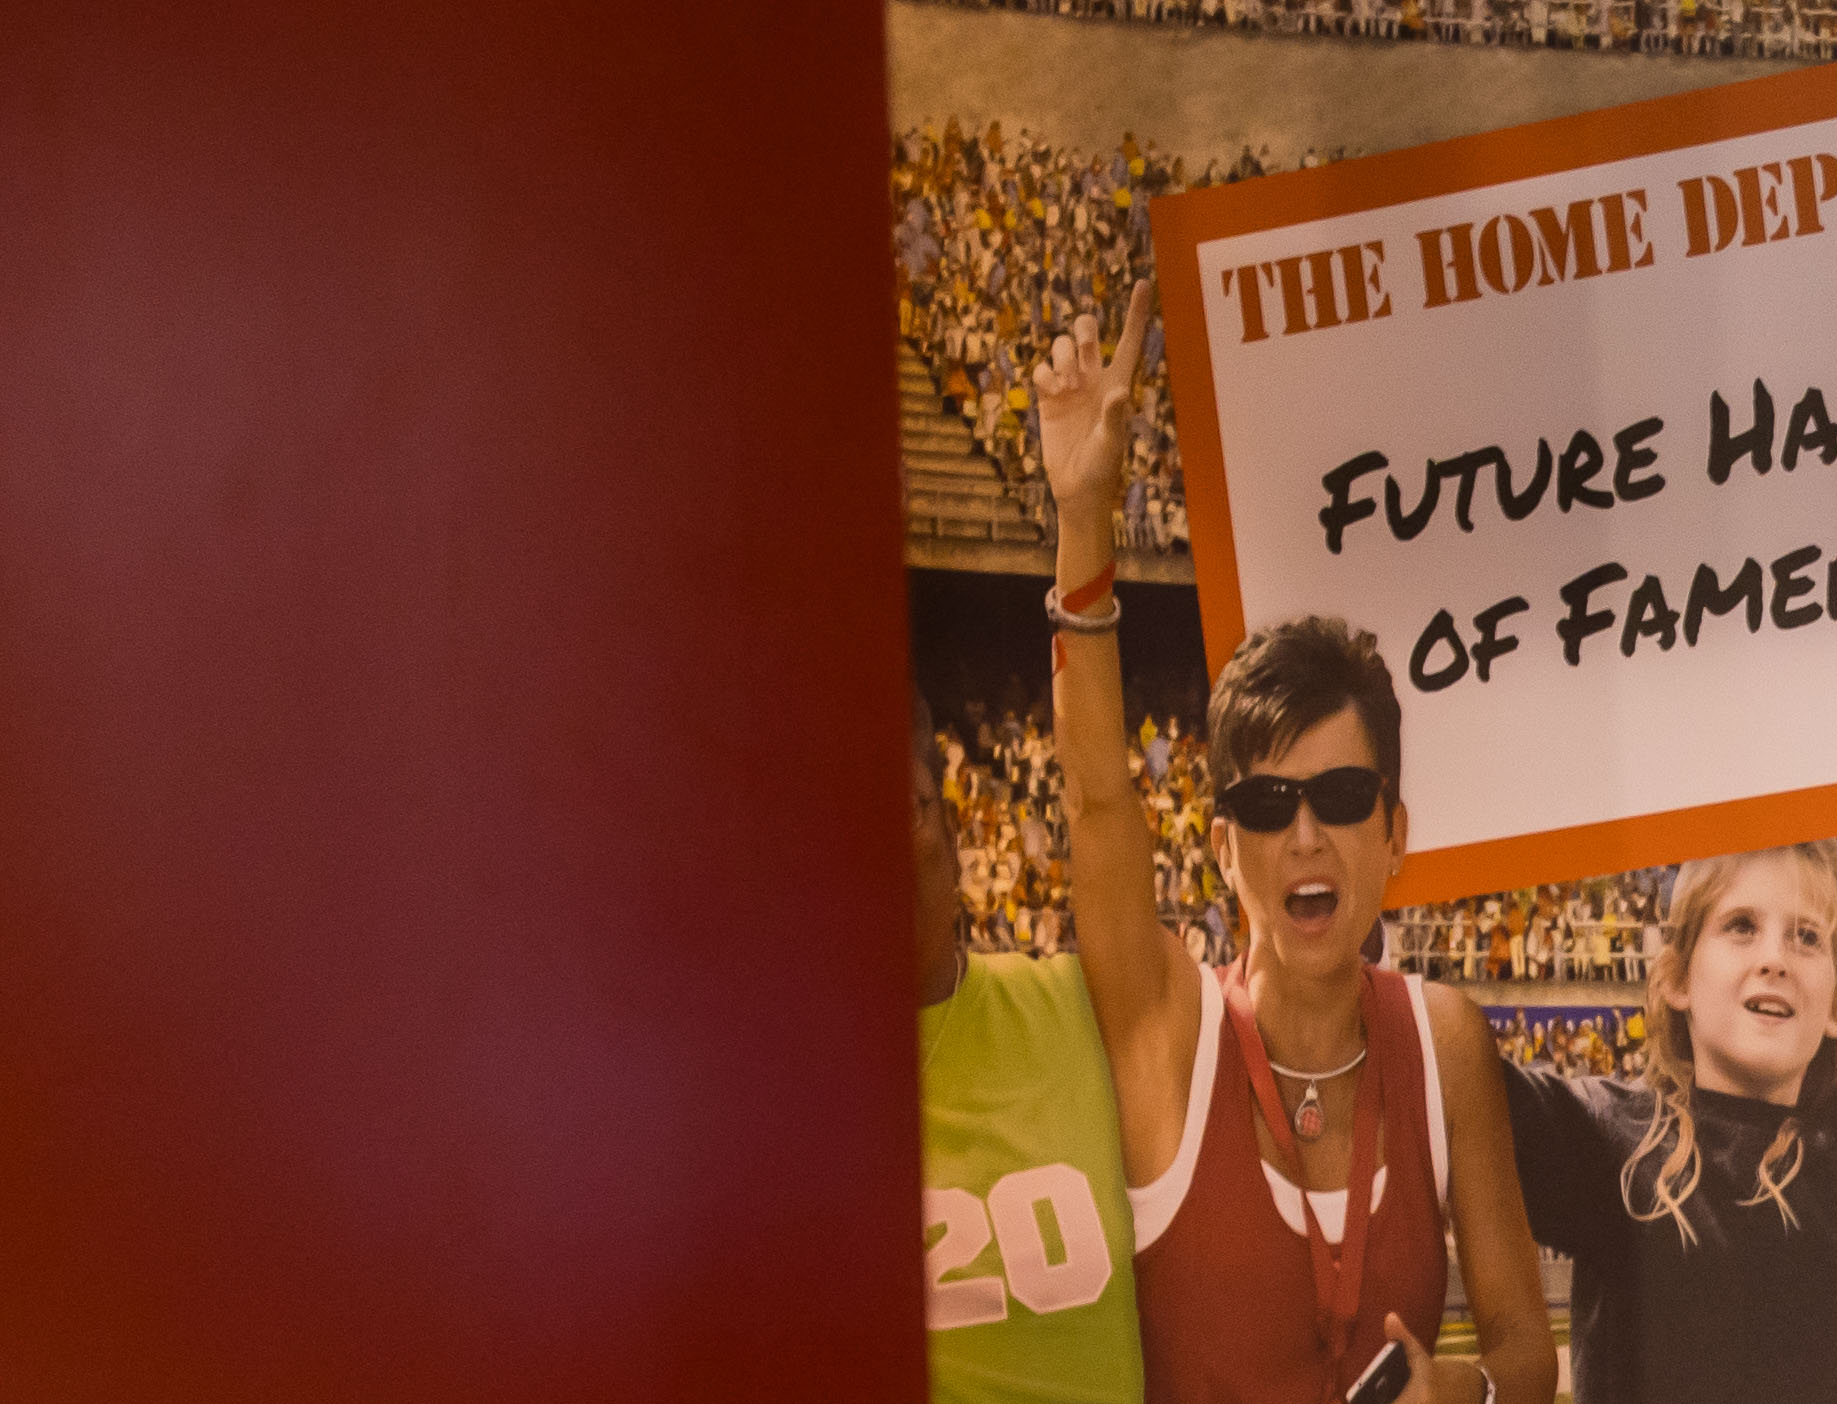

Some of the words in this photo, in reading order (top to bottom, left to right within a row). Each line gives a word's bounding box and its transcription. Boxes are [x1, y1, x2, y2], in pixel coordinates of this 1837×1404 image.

[1222, 237, 1393, 345] THE
[1413, 188, 1655, 310] HOME
[1318, 416, 1667, 557] FUTURE
[1409, 595, 1531, 693] OF
[924, 1162, 1112, 1331] 20
